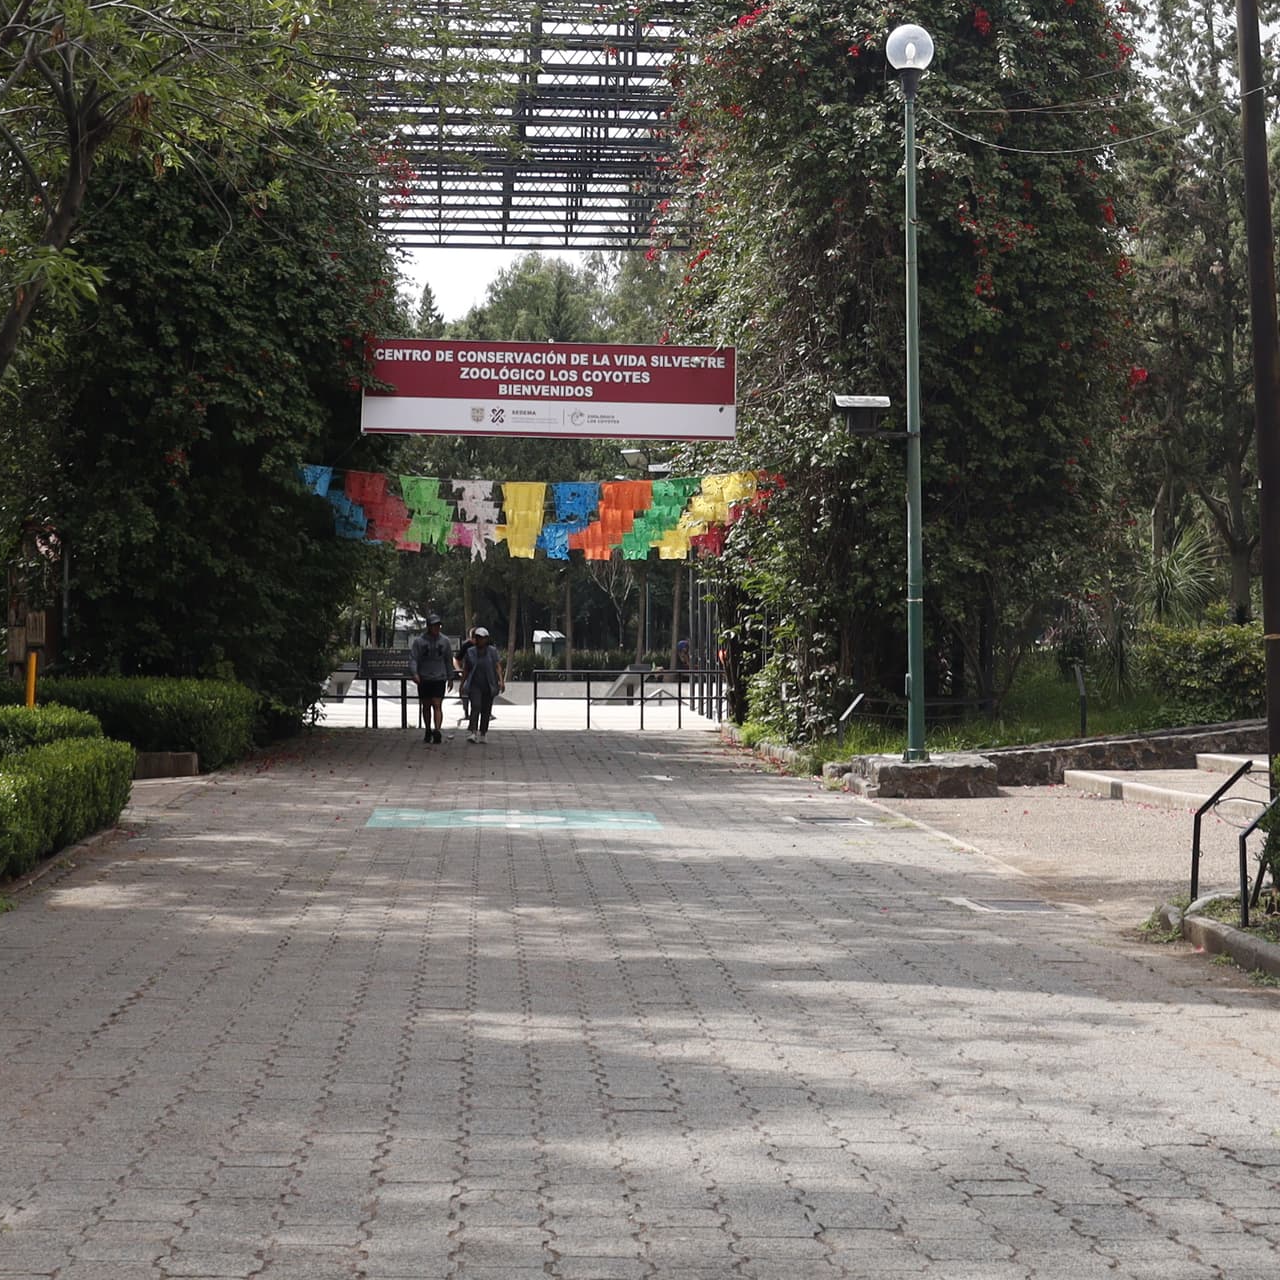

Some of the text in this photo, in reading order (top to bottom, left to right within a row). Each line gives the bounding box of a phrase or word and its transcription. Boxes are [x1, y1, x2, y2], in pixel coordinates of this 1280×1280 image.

[375, 348, 726, 369] CENTRO DE CONSERVACIÓN DE LA VIDA SILVESTRE
[459, 365, 650, 384] ZOOLÓGICO LOS COYOTES
[498, 384, 593, 398] BIENVENIDOS
